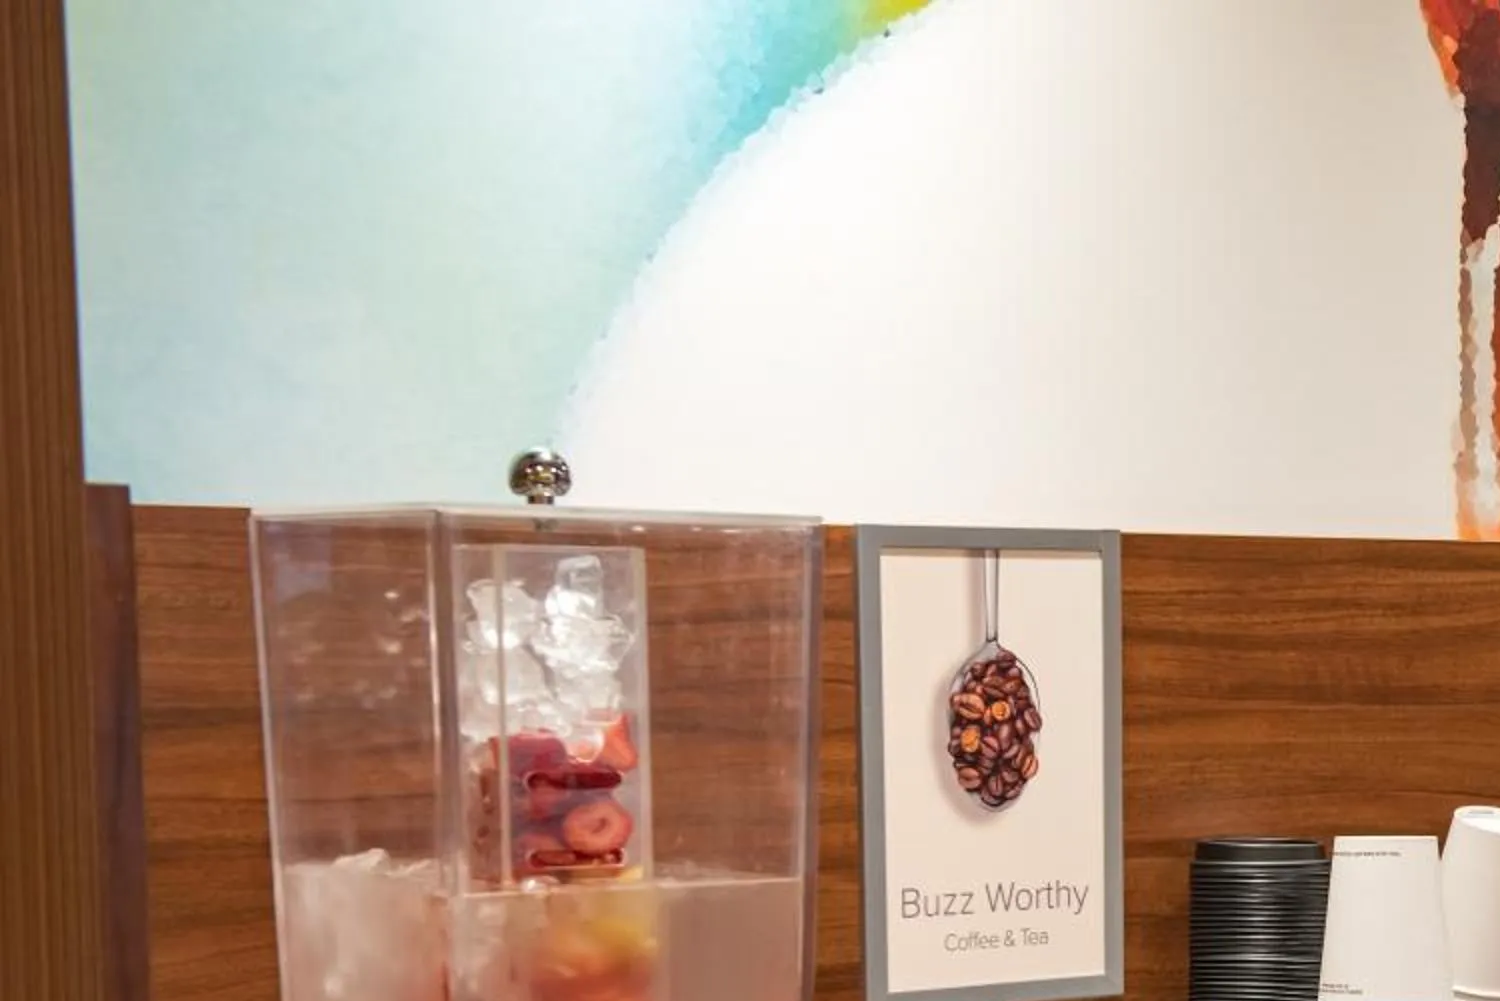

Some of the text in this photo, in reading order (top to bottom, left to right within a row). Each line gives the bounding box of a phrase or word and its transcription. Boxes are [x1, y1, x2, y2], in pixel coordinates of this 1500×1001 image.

[900, 879, 1090, 919] Buzz Worthy
[943, 927, 1050, 952] Coffee & Tea
